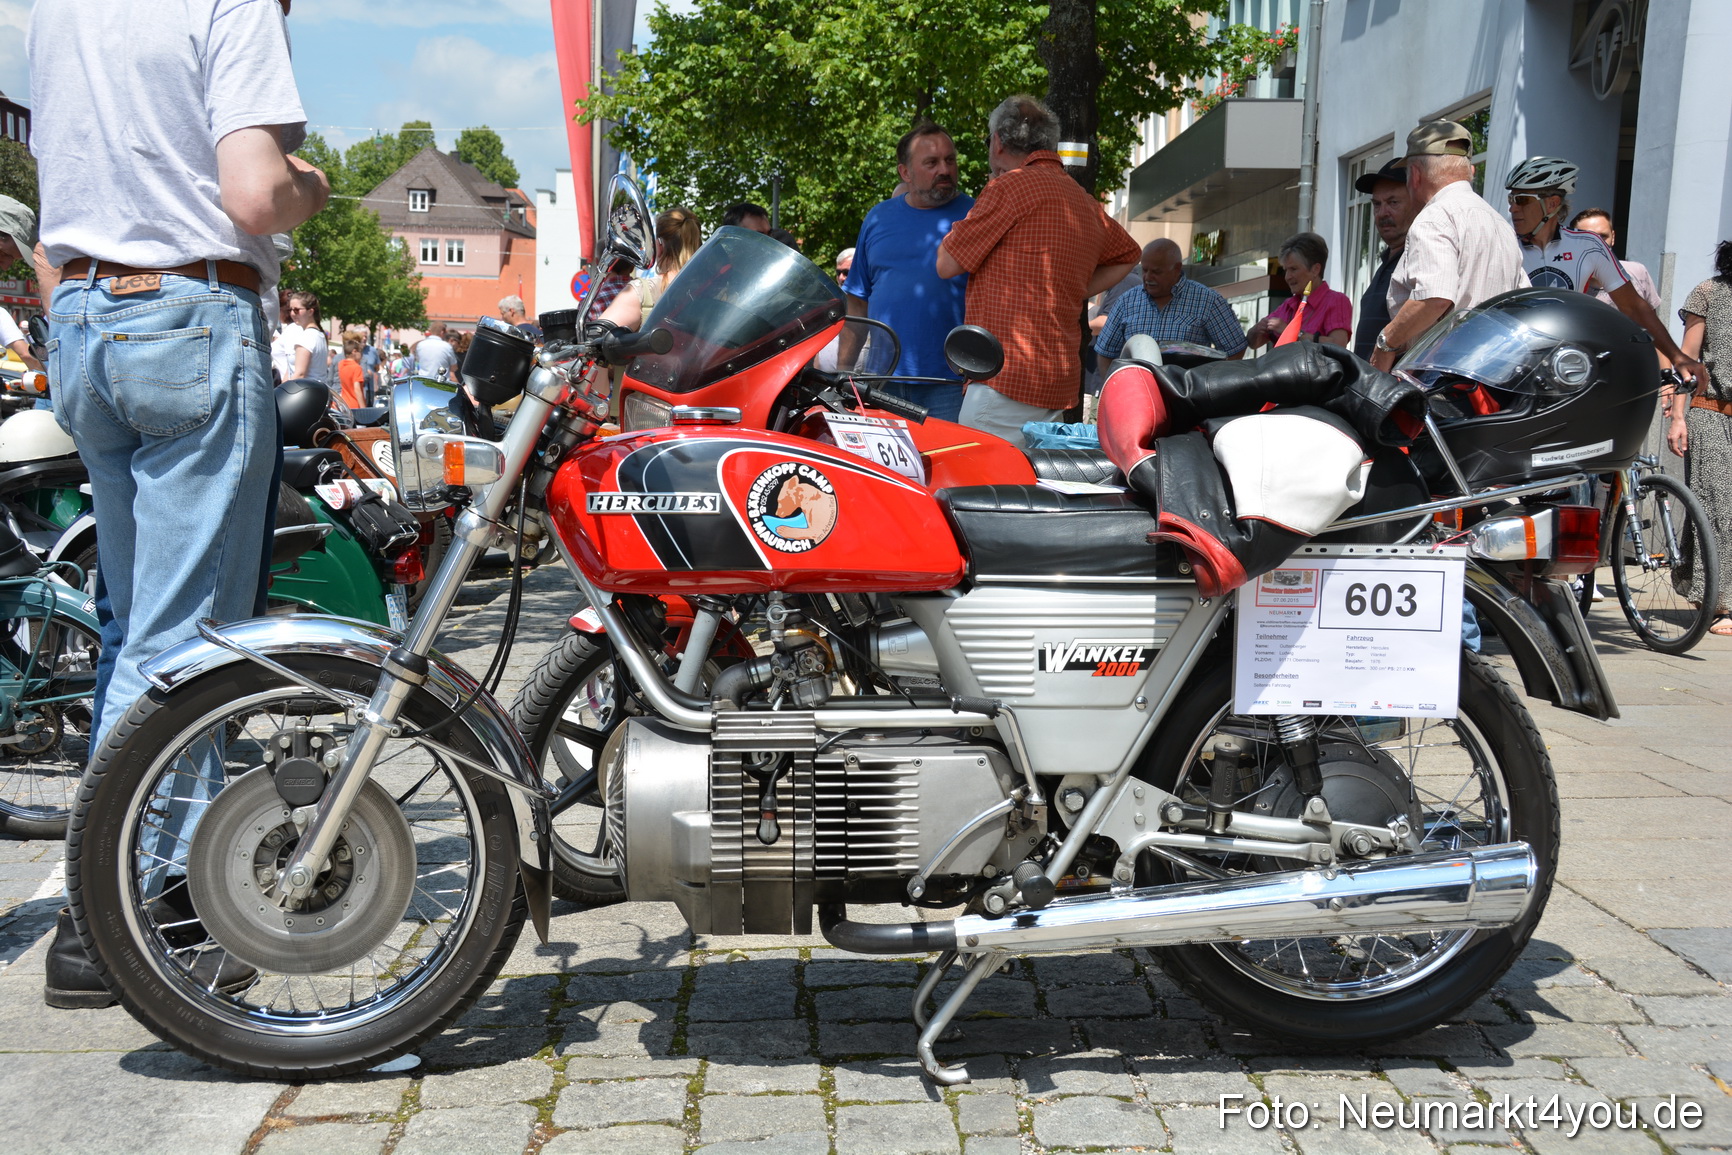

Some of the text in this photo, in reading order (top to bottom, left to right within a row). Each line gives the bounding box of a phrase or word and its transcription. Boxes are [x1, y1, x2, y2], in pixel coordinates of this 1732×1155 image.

[1544, 176, 1564, 186] RUDY
[115, 274, 158, 290] Lee
[878, 442, 908, 466] 614
[1540, 446, 1606, 463] Ludwig Guttenberger
[748, 463, 834, 518] BÄRENKOPF CAMP
[590, 496, 716, 512] HERCULES
[752, 521, 812, 552] MAURACH
[1632, 530, 1644, 556] SID
[1346, 582, 1417, 617] 603
[1043, 638, 1166, 673] WANKEL
[1092, 662, 1140, 676] 2000
